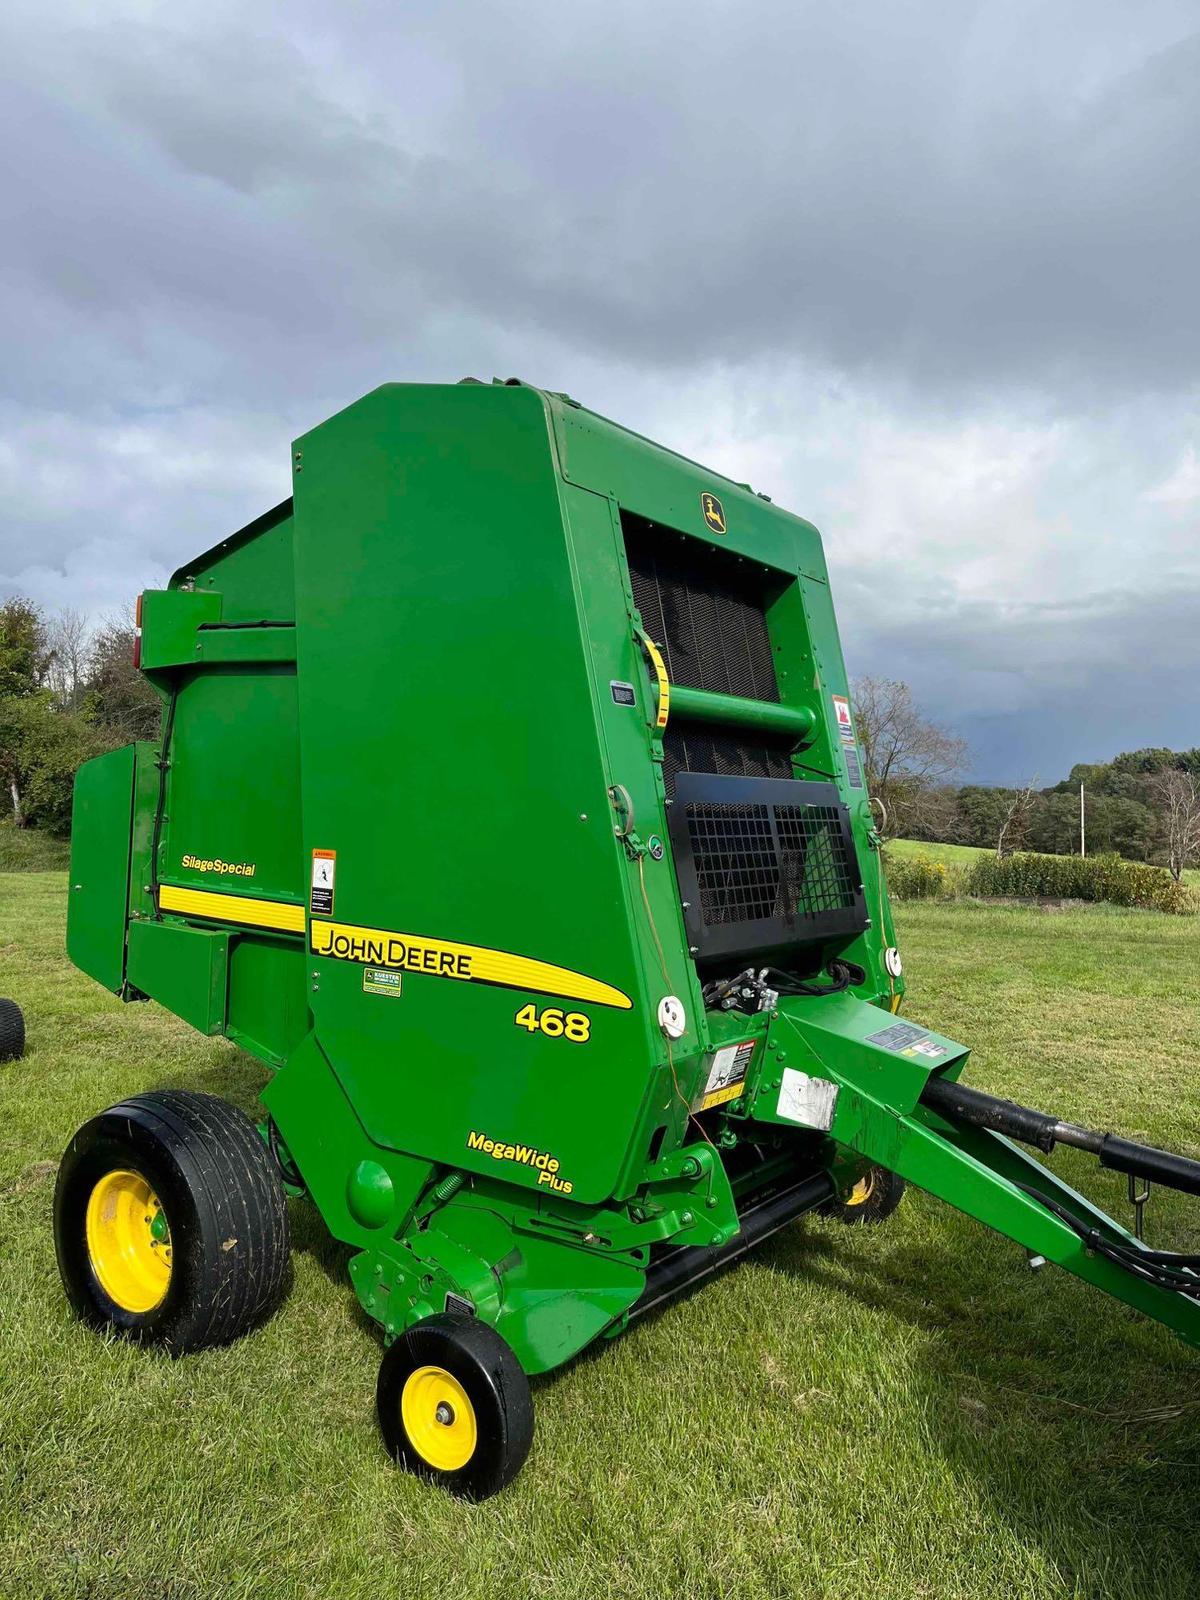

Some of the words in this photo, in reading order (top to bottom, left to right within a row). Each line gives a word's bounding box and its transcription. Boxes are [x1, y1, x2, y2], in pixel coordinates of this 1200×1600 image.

[181, 855, 256, 876] SilageSpecial
[321, 930, 383, 961] JOHN
[388, 939, 473, 976] DEERE
[514, 1004, 590, 1042] 468
[467, 1131, 560, 1173] MegaWide
[537, 1170, 574, 1194] Plus
